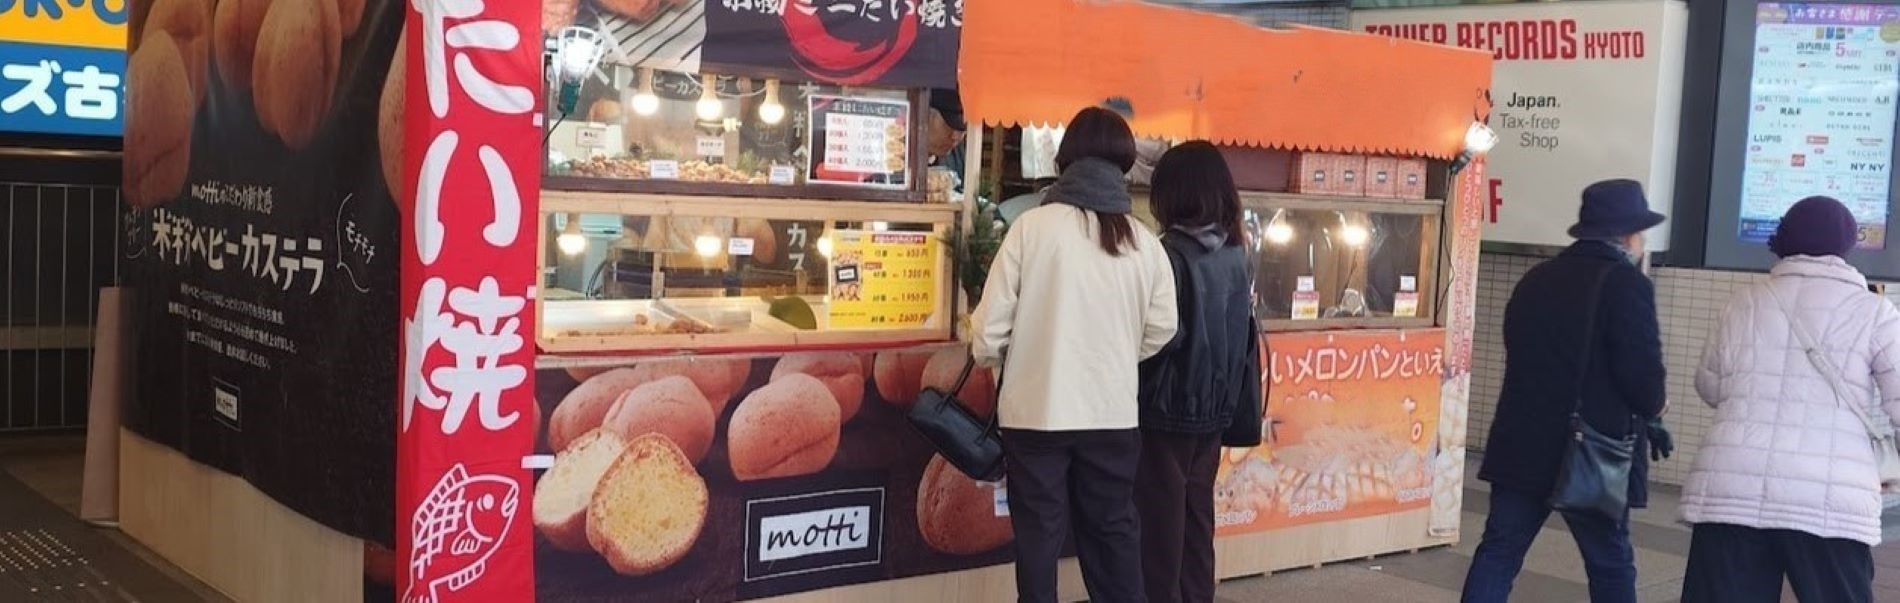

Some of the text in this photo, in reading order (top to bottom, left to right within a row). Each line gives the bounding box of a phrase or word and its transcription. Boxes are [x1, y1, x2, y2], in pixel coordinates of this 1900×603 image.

[1457, 19, 1577, 60] RECORDS
[1584, 31, 1644, 59] KYOTO
[1500, 113, 1560, 130] Tax-free
[1507, 92, 1561, 112] Japan.
[1520, 132, 1559, 151] Shop
[1851, 162, 1885, 172] NY NY
[1481, 178, 1503, 223] F
[152, 208, 324, 295] 米粉ベビーカステラ
[345, 219, 375, 265] モチモチ
[1262, 343, 1444, 384] いメロンパンといえ
[767, 510, 863, 551] motti
